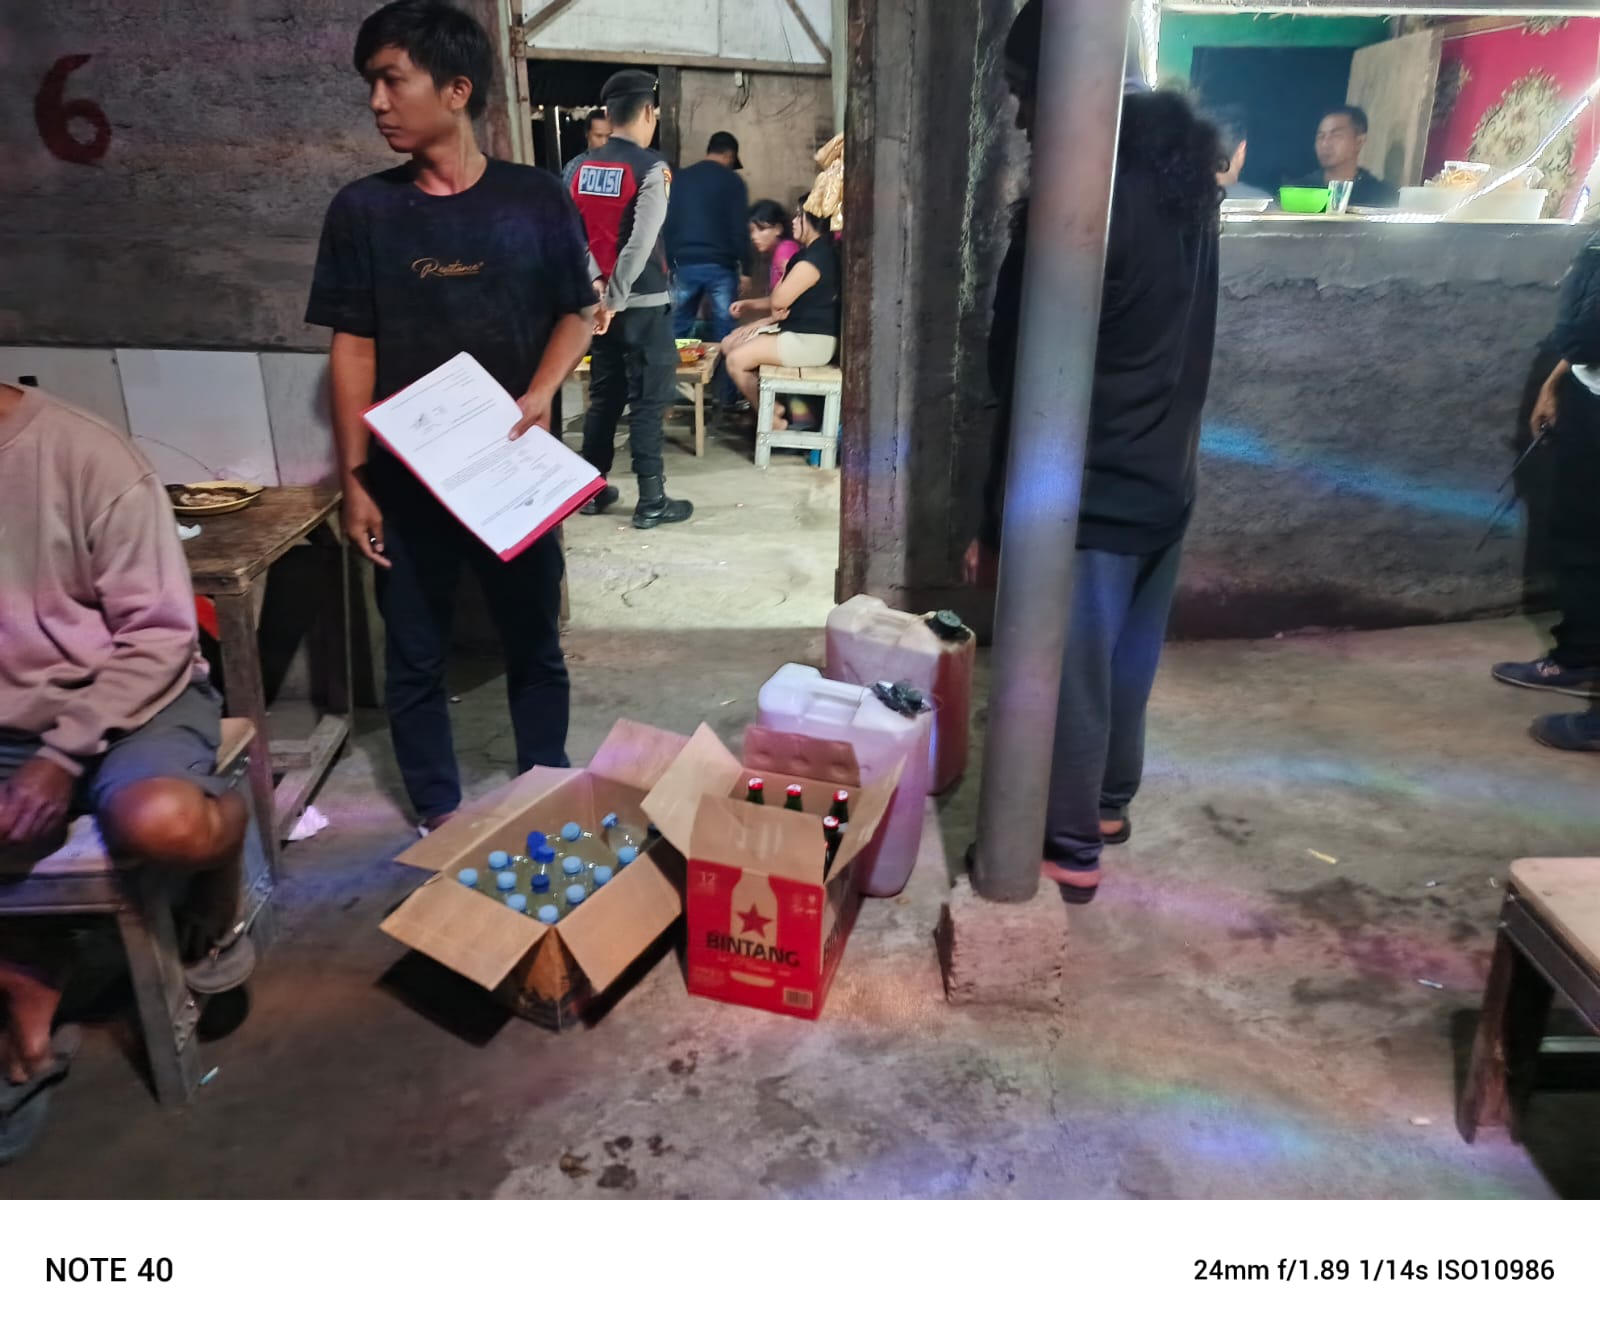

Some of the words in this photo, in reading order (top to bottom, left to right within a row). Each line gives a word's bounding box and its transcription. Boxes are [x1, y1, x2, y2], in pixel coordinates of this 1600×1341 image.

[34, 54, 112, 166] 6
[581, 168, 620, 193] POLISI
[706, 932, 800, 967] BINTANG
